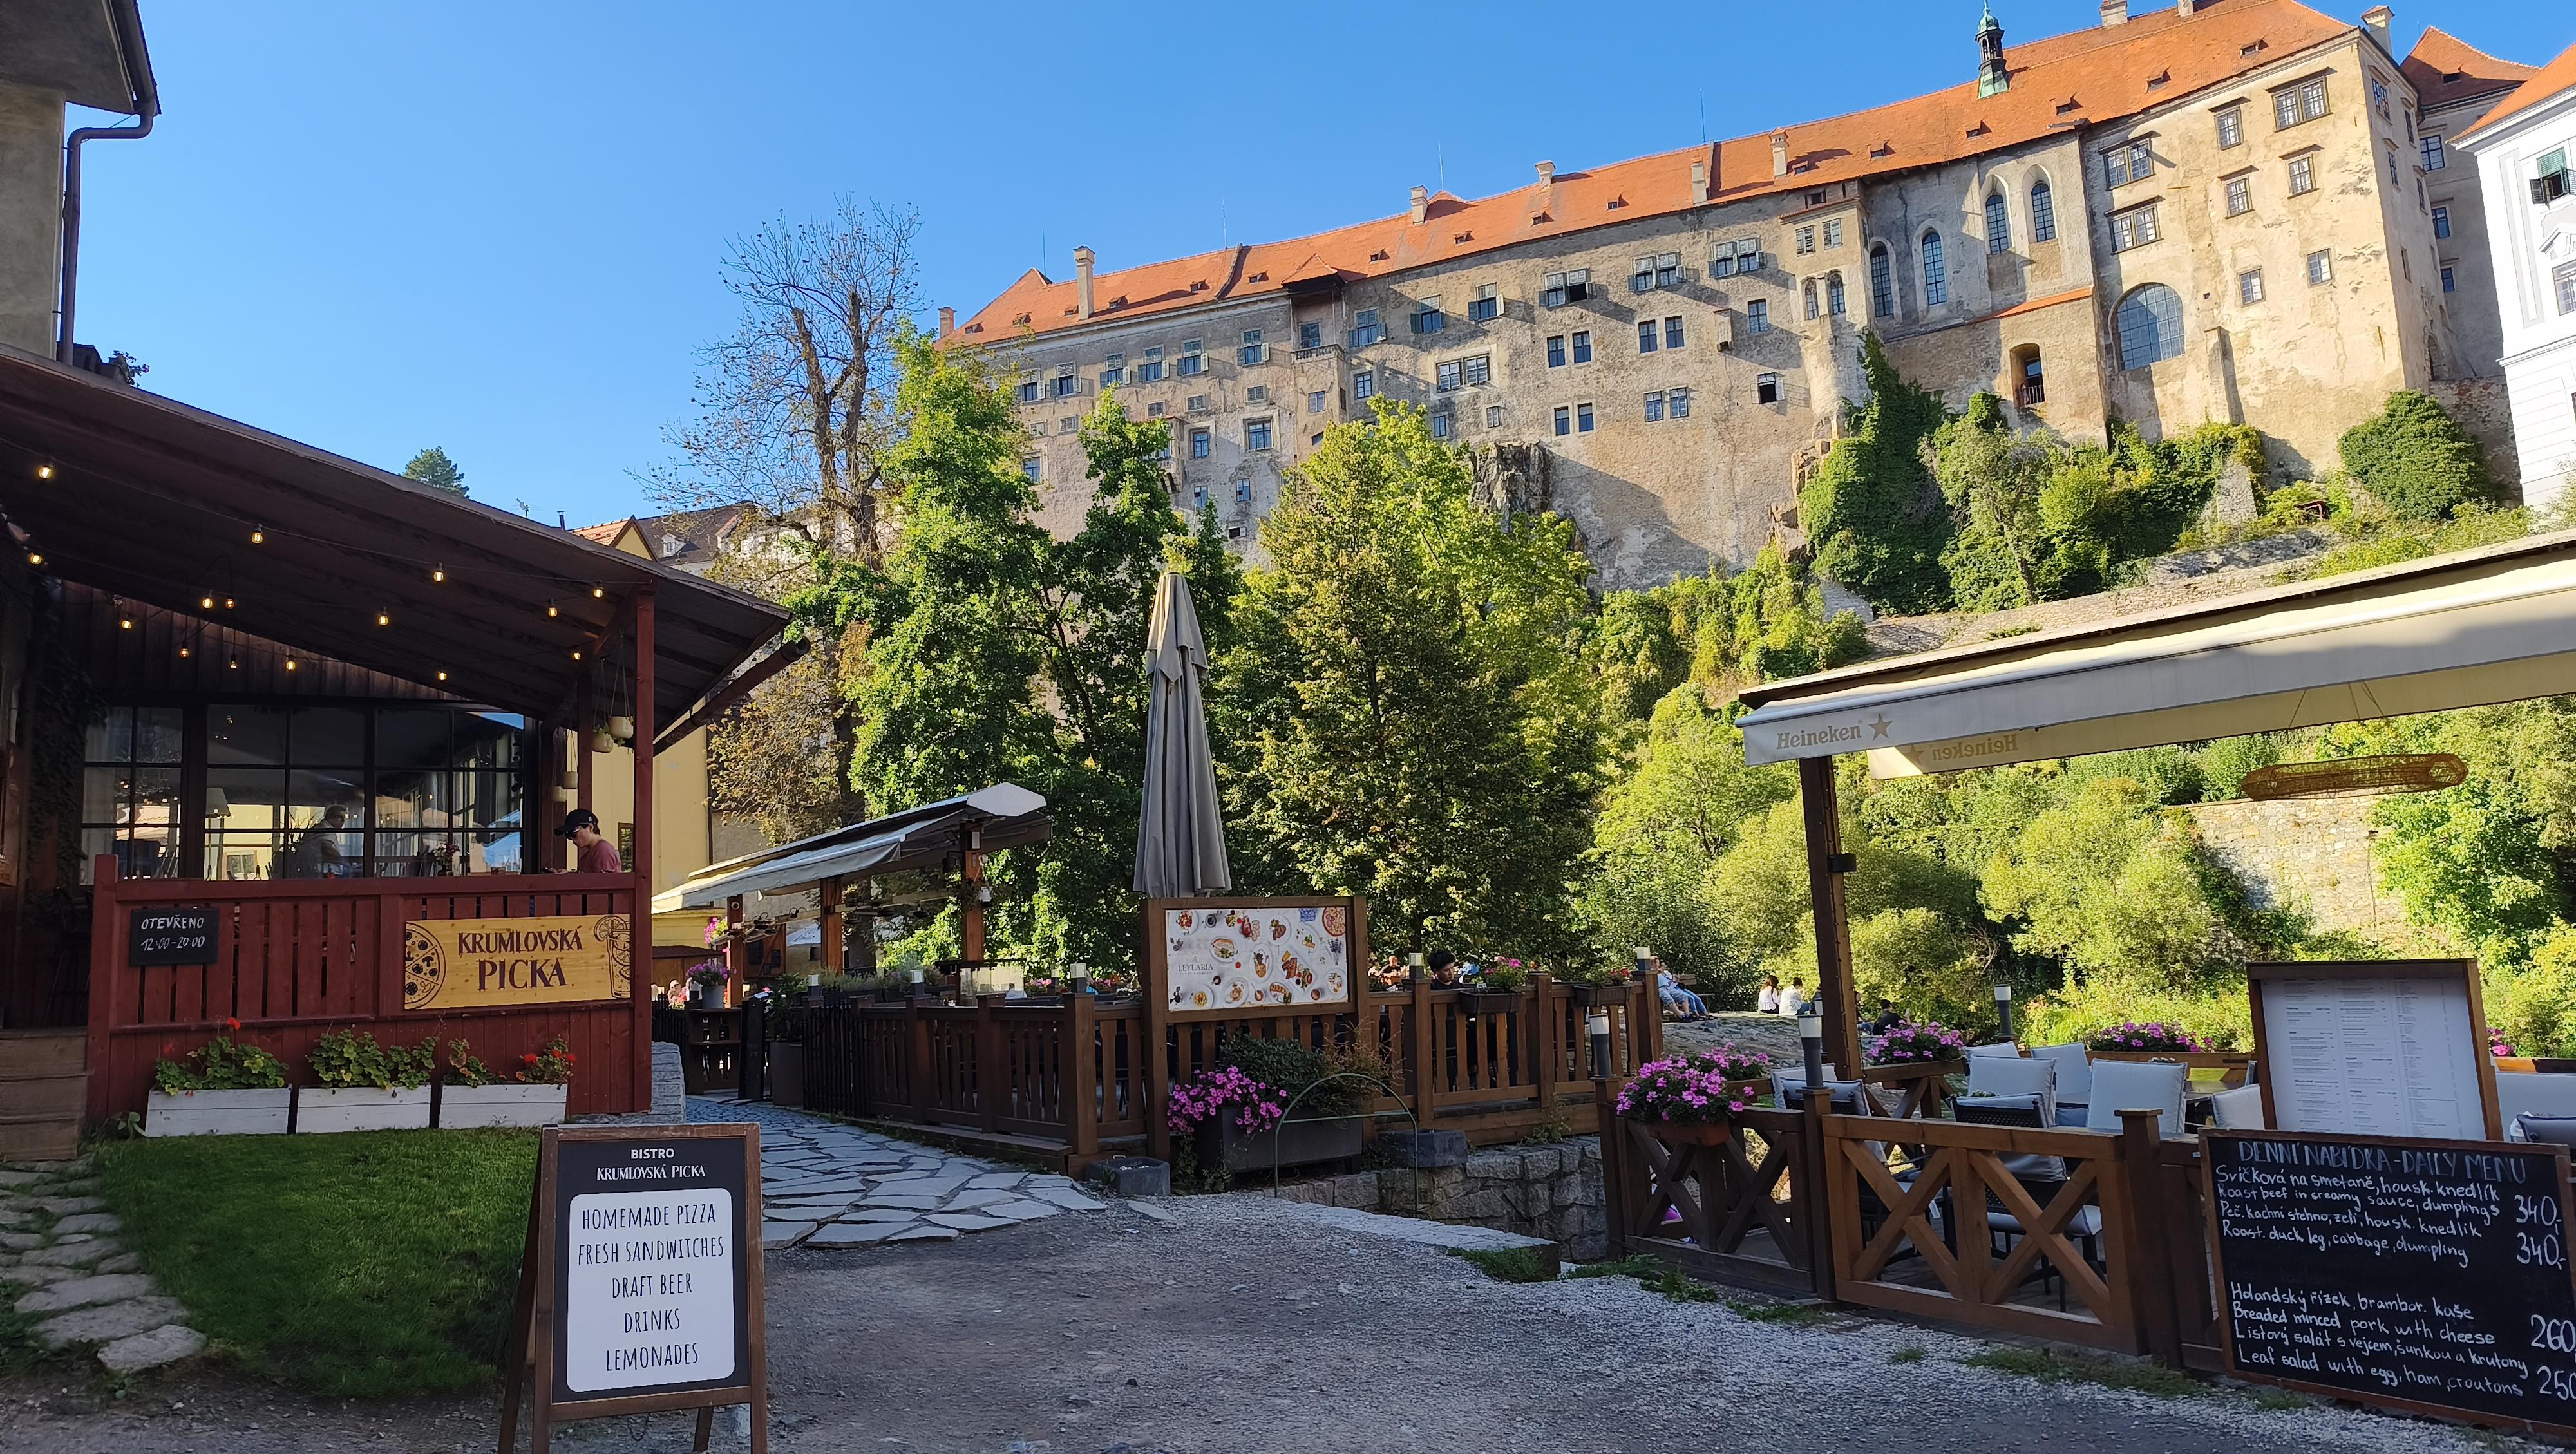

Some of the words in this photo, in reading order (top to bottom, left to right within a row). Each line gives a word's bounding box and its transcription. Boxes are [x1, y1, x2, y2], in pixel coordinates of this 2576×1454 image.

[1776, 724, 1862, 750] Heineken
[140, 914, 204, 930] OTEVŘENO
[458, 925, 585, 958] KRUMLOVSKÁ
[477, 957, 569, 992] PICKA
[1178, 963, 1213, 972] LEYLARIA
[630, 1148, 675, 1160] BISTRO
[2239, 1142, 2300, 1164] DENNÍ
[2304, 1144, 2392, 1173] NABÍDKA
[2402, 1150, 2456, 1178] DAILY
[2465, 1154, 2526, 1184] MENU
[596, 1164, 667, 1181] KRUMLOVSKÁ
[672, 1165, 706, 1178] PICKA
[2290, 1175, 2308, 1186] na
[2436, 1181, 2500, 1202] knedlík
[582, 1205, 669, 1229] HOMEMADE
[677, 1203, 715, 1225] PIZZA
[2217, 1184, 2257, 1200] Roast
[2260, 1186, 2287, 1200] beef
[2295, 1190, 2307, 1198] in
[2311, 1191, 2361, 1212] creamy
[2423, 1197, 2500, 1226] dumplings
[2221, 1200, 2244, 1218] Peč.
[2269, 1225, 2304, 1242] duck
[578, 1242, 618, 1265] FRESH
[625, 1236, 724, 1262] SANDWITCHES
[612, 1276, 652, 1298] DRAFT
[660, 1272, 692, 1295] BEER
[2358, 1292, 2427, 1313] brambor.
[2432, 1296, 2474, 1319] kaše
[624, 1308, 680, 1333] DRINKS
[2233, 1301, 2287, 1323] Breaded
[2293, 1311, 2341, 1328] minced
[2351, 1317, 2389, 1335] pork
[2394, 1319, 2433, 1339] with
[2439, 1323, 2496, 1344] cheese
[606, 1342, 698, 1372] LEMONADES
[2234, 1320, 2289, 1346] Listový
[2294, 1328, 2331, 1346] salát
[2337, 1337, 2346, 1347] s
[2456, 1353, 2465, 1363] a
[2469, 1349, 2528, 1379] krutony
[2239, 1344, 2275, 1365] Leaf
[2281, 1349, 2320, 1372] salad
[2328, 1357, 2364, 1375] with
[2403, 1365, 2441, 1386] ham
